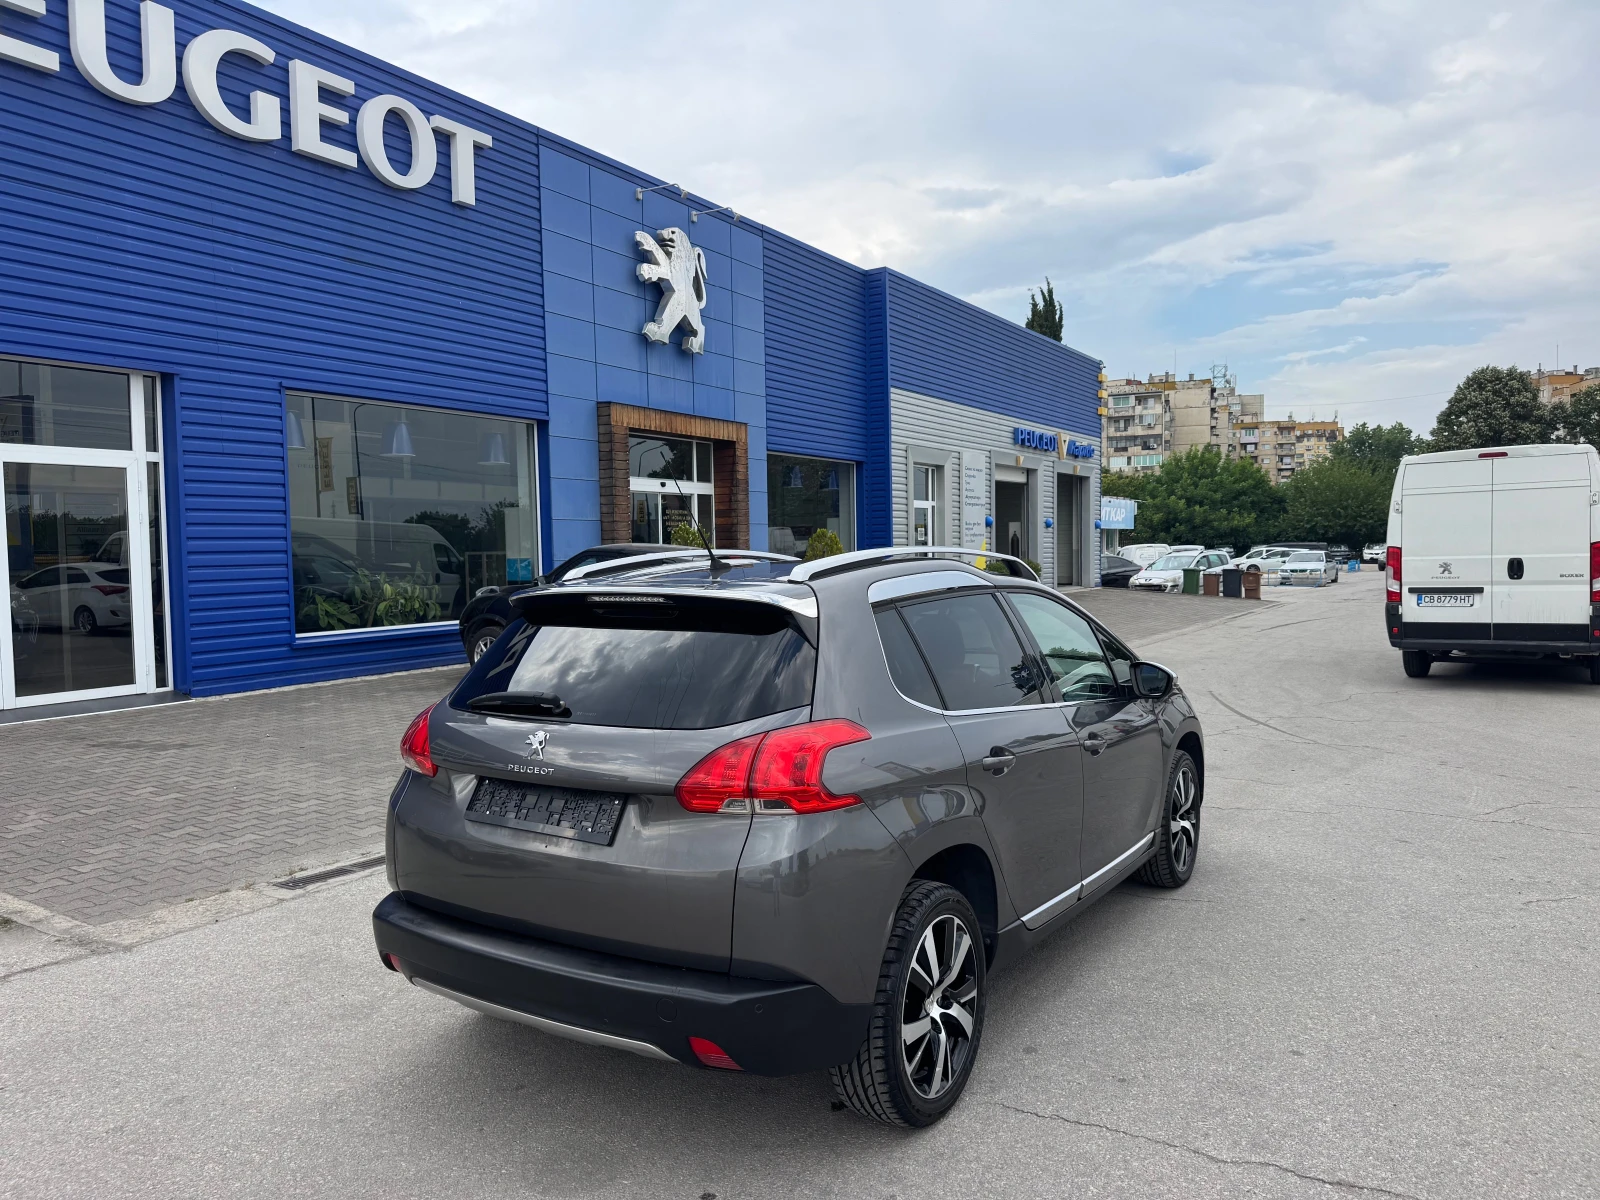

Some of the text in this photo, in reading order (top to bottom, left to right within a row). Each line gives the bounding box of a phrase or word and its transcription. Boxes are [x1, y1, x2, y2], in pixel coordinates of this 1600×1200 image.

[1016, 427, 1059, 452] PEUGEOT
[1423, 595, 1472, 604] CB 8779 HT
[508, 764, 554, 775] PEUGEOT
